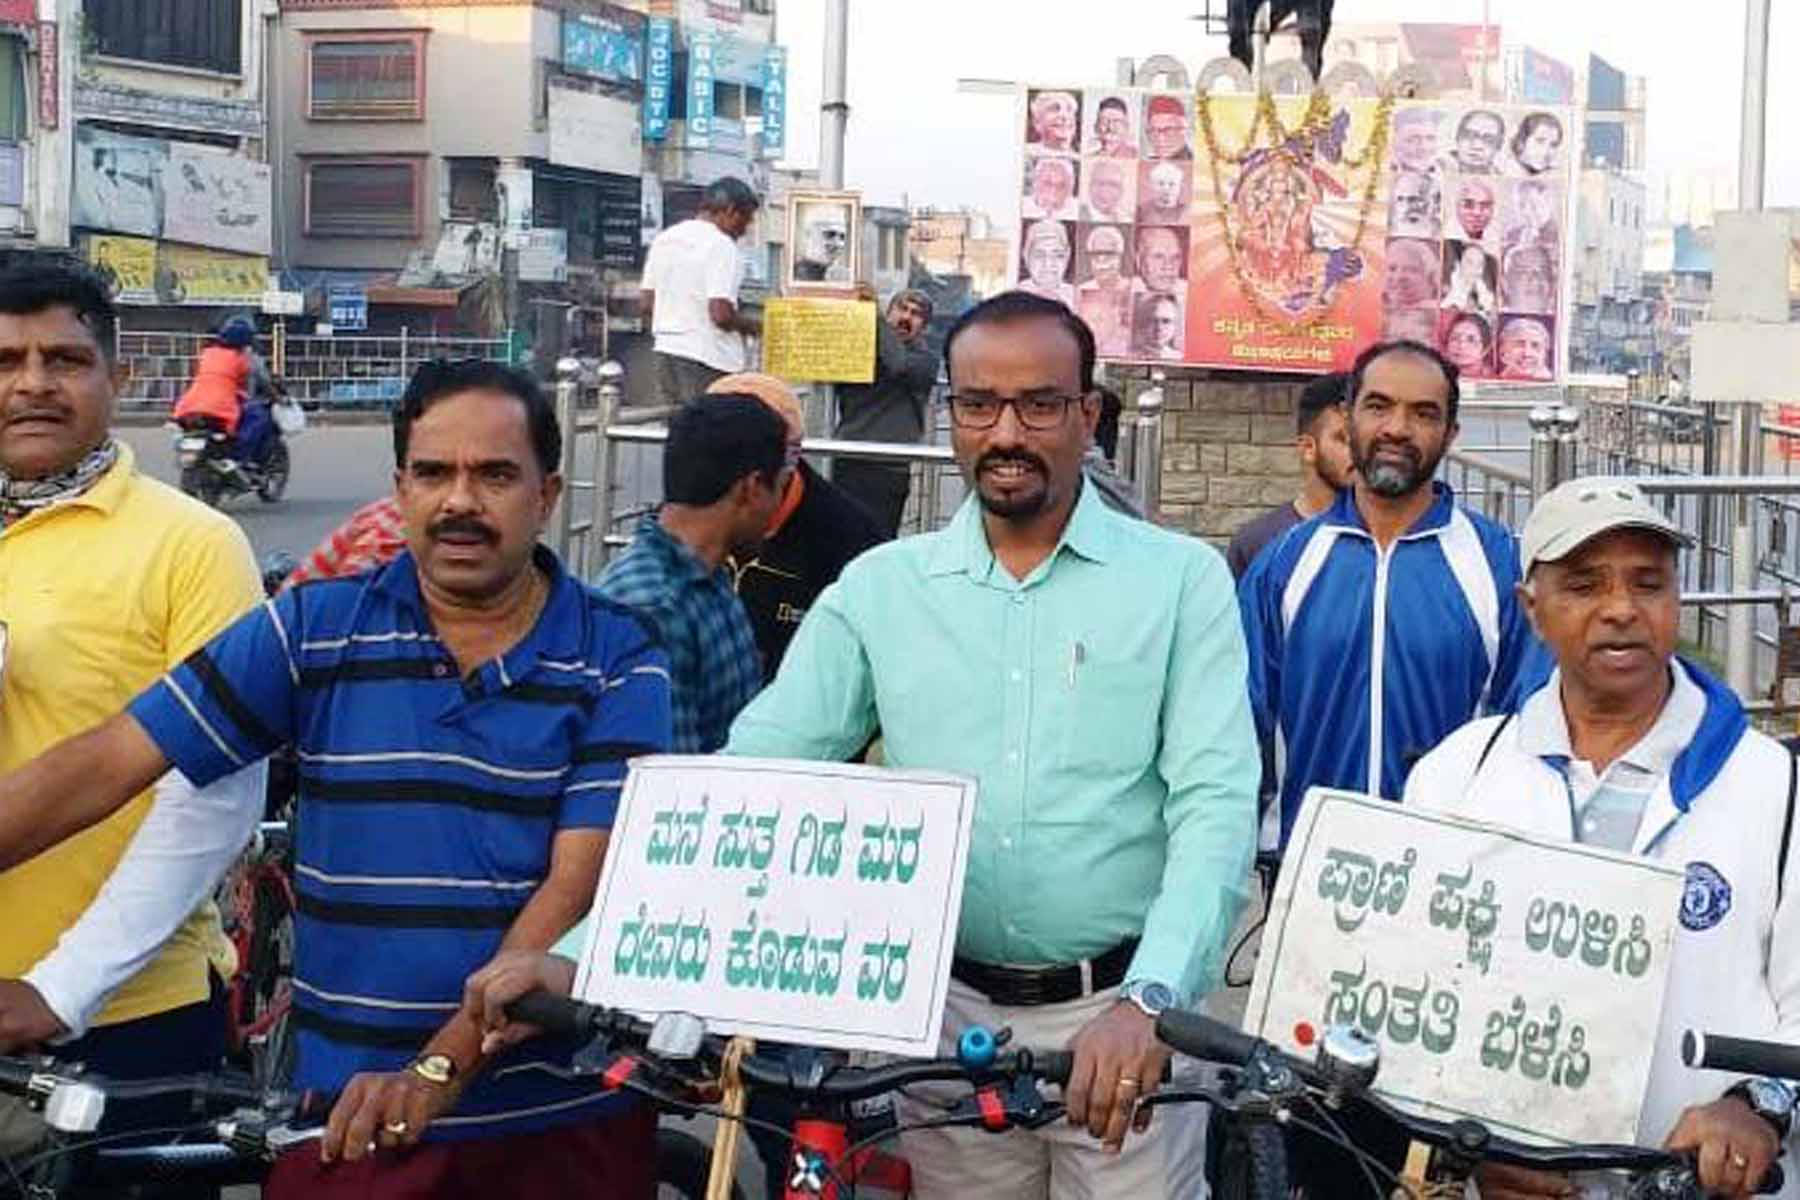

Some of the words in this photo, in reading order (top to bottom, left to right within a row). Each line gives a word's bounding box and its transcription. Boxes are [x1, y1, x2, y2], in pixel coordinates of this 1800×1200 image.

[690, 44, 711, 134] BASIC
[764, 61, 782, 145] TALLY
[646, 795, 708, 866] ಮನೆ
[712, 804, 781, 898] ಸುತ್ತ
[789, 808, 848, 878] ಗಿಡ
[857, 809, 924, 884] ಮರ
[614, 903, 711, 983] ದೇವರು
[724, 910, 848, 997] ಕೊಡುವ
[856, 923, 913, 1003] ವರ
[1317, 848, 1418, 932] ಪ್ರಾಣಿ
[1429, 863, 1502, 975] ಪಕ್ಷಿ
[1524, 898, 1652, 977] ಉಳಿಸಿ
[1323, 956, 1460, 1055] ಸಂತತಿ
[1480, 996, 1592, 1090] ಬೆಳೆಸಿ
